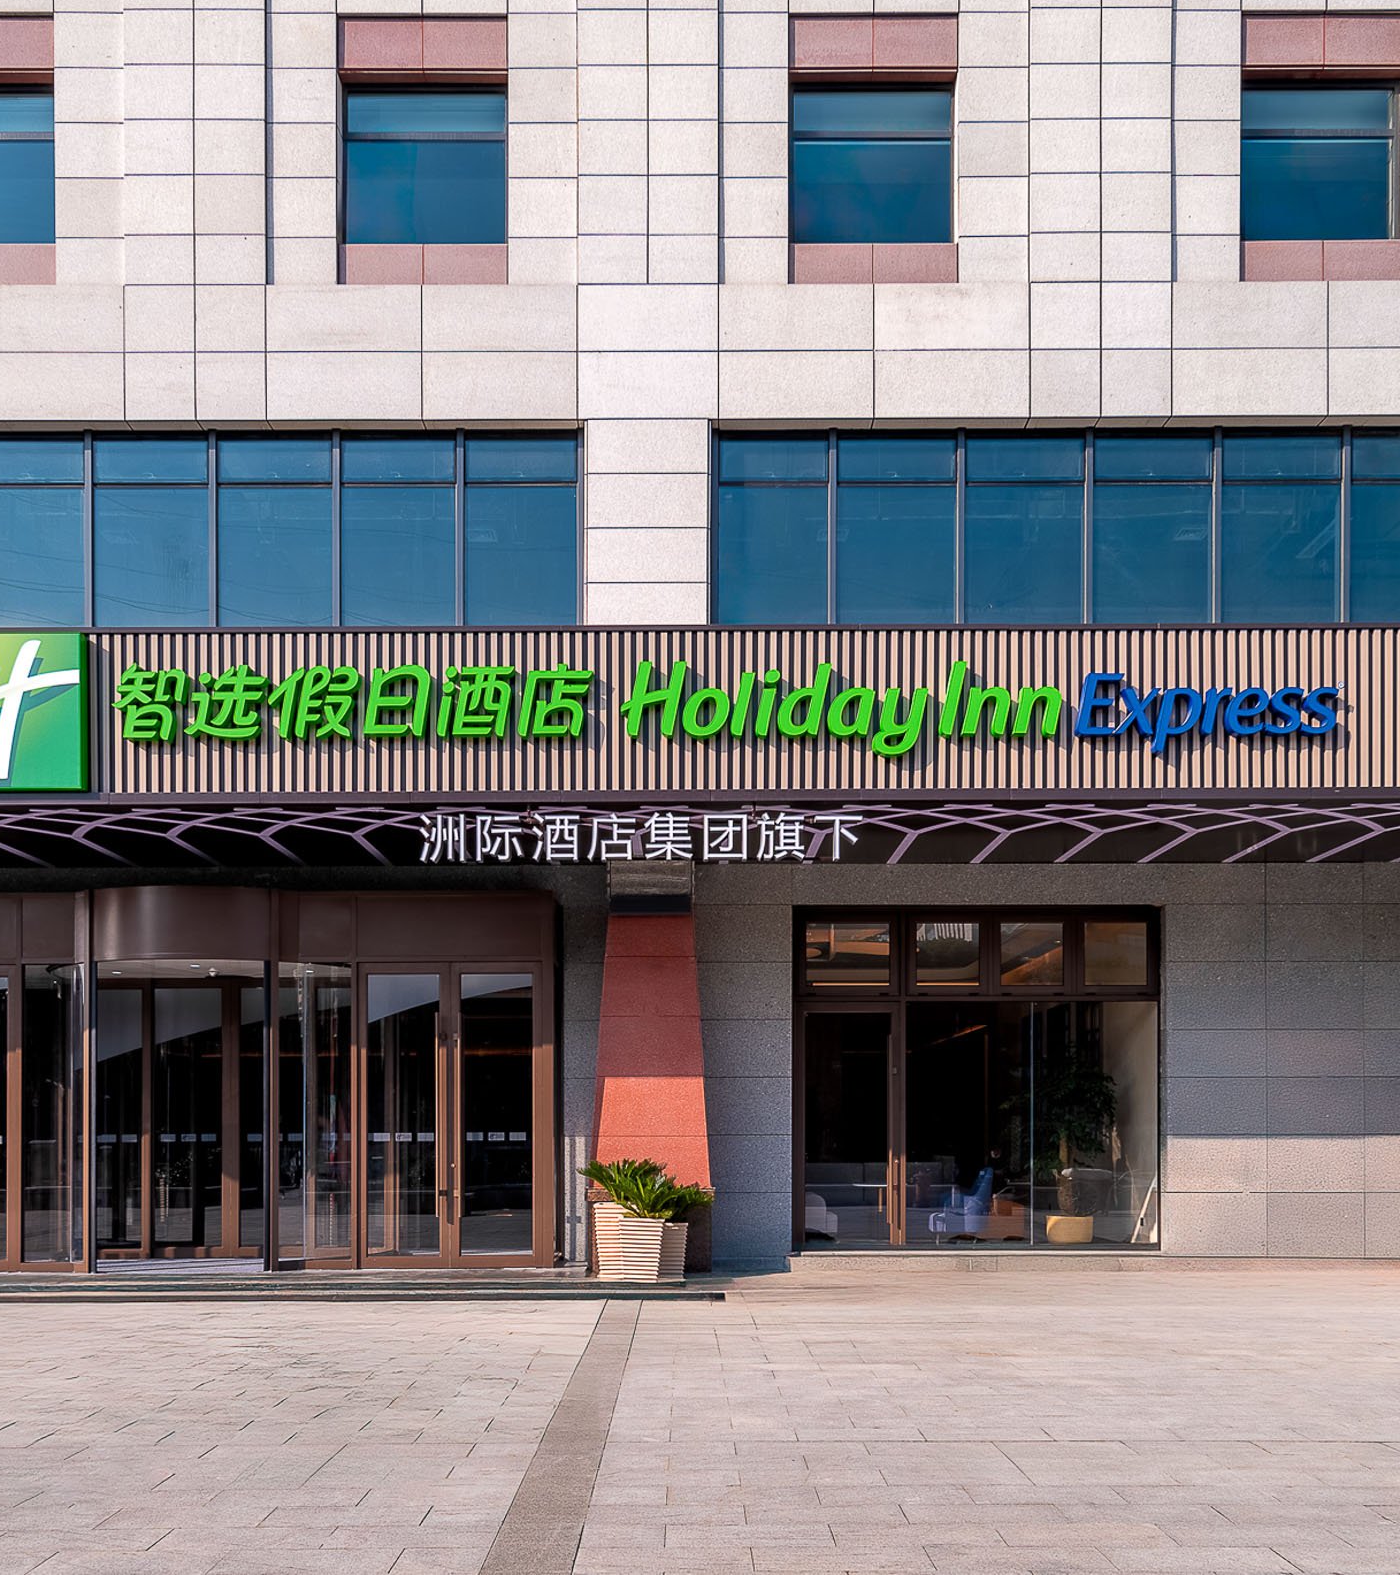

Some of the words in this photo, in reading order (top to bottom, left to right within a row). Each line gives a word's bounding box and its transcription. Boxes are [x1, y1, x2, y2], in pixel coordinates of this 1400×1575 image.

[112, 662, 594, 742] 智选假日酒店
[620, 660, 929, 757] Holiday
[938, 660, 1062, 738] Inn
[1074, 672, 1339, 754] Express
[419, 812, 863, 862] 洲际酒店集团旗下
